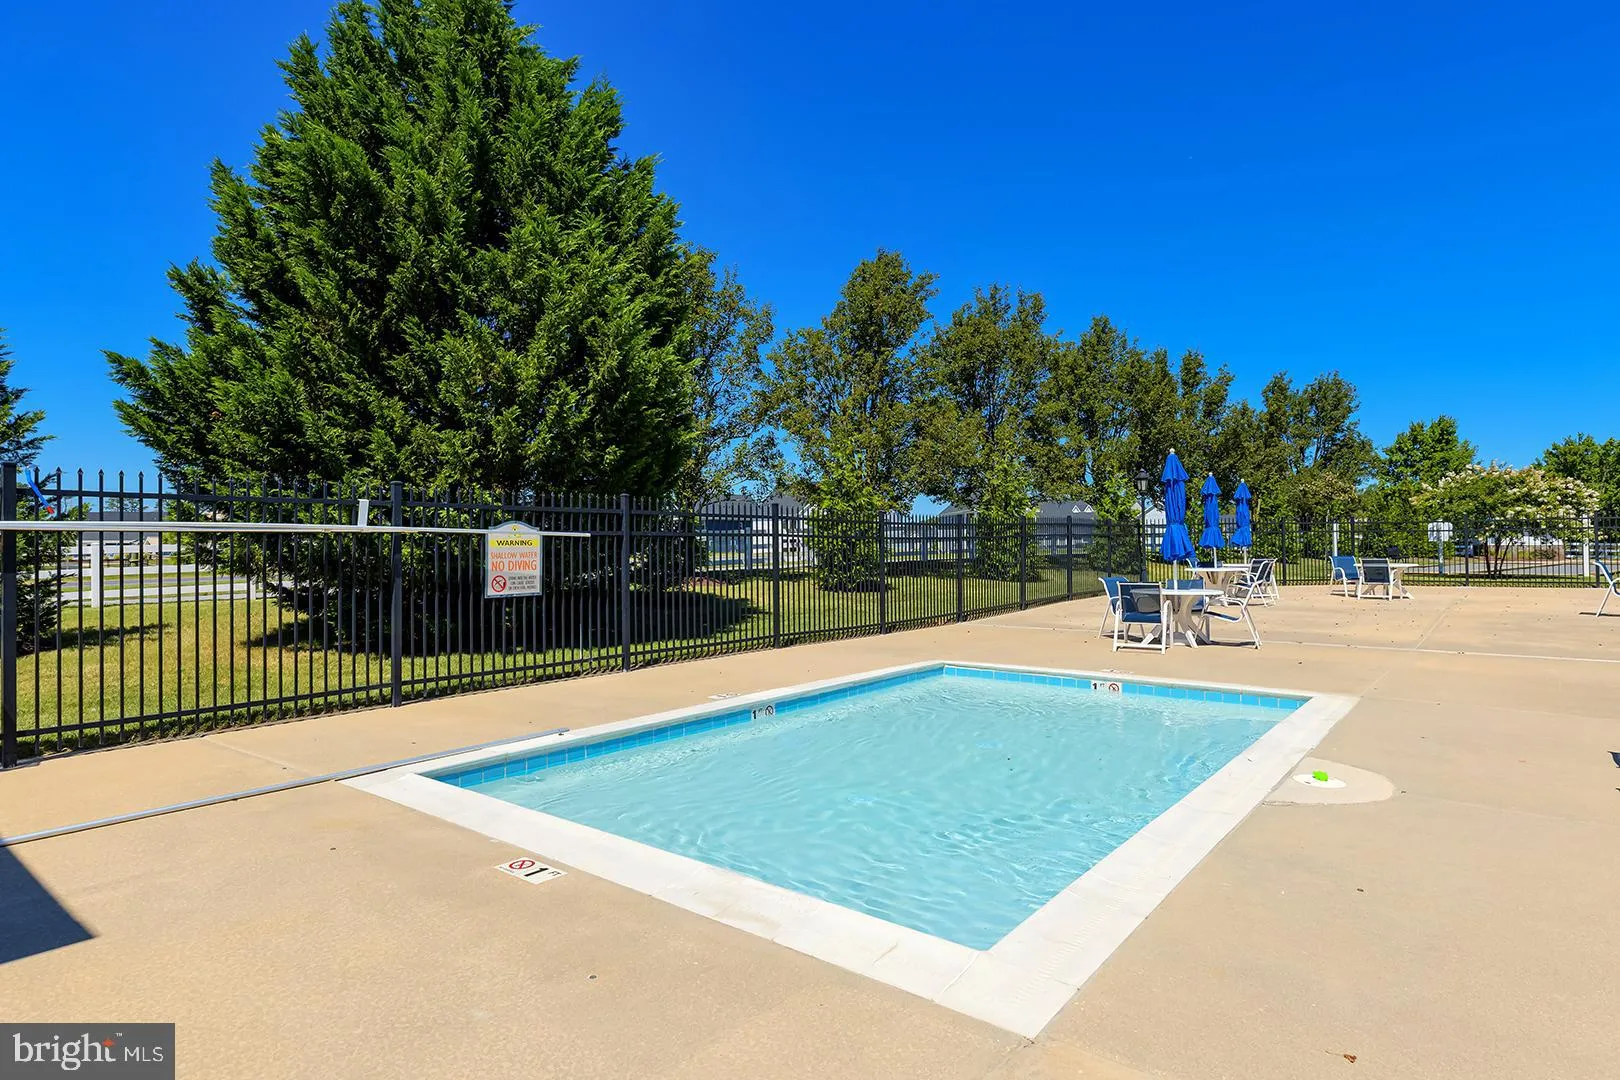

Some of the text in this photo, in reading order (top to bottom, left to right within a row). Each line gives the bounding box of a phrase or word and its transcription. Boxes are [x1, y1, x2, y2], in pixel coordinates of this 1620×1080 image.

[491, 560, 537, 572] NO DIVING
[524, 868, 549, 877] 1
